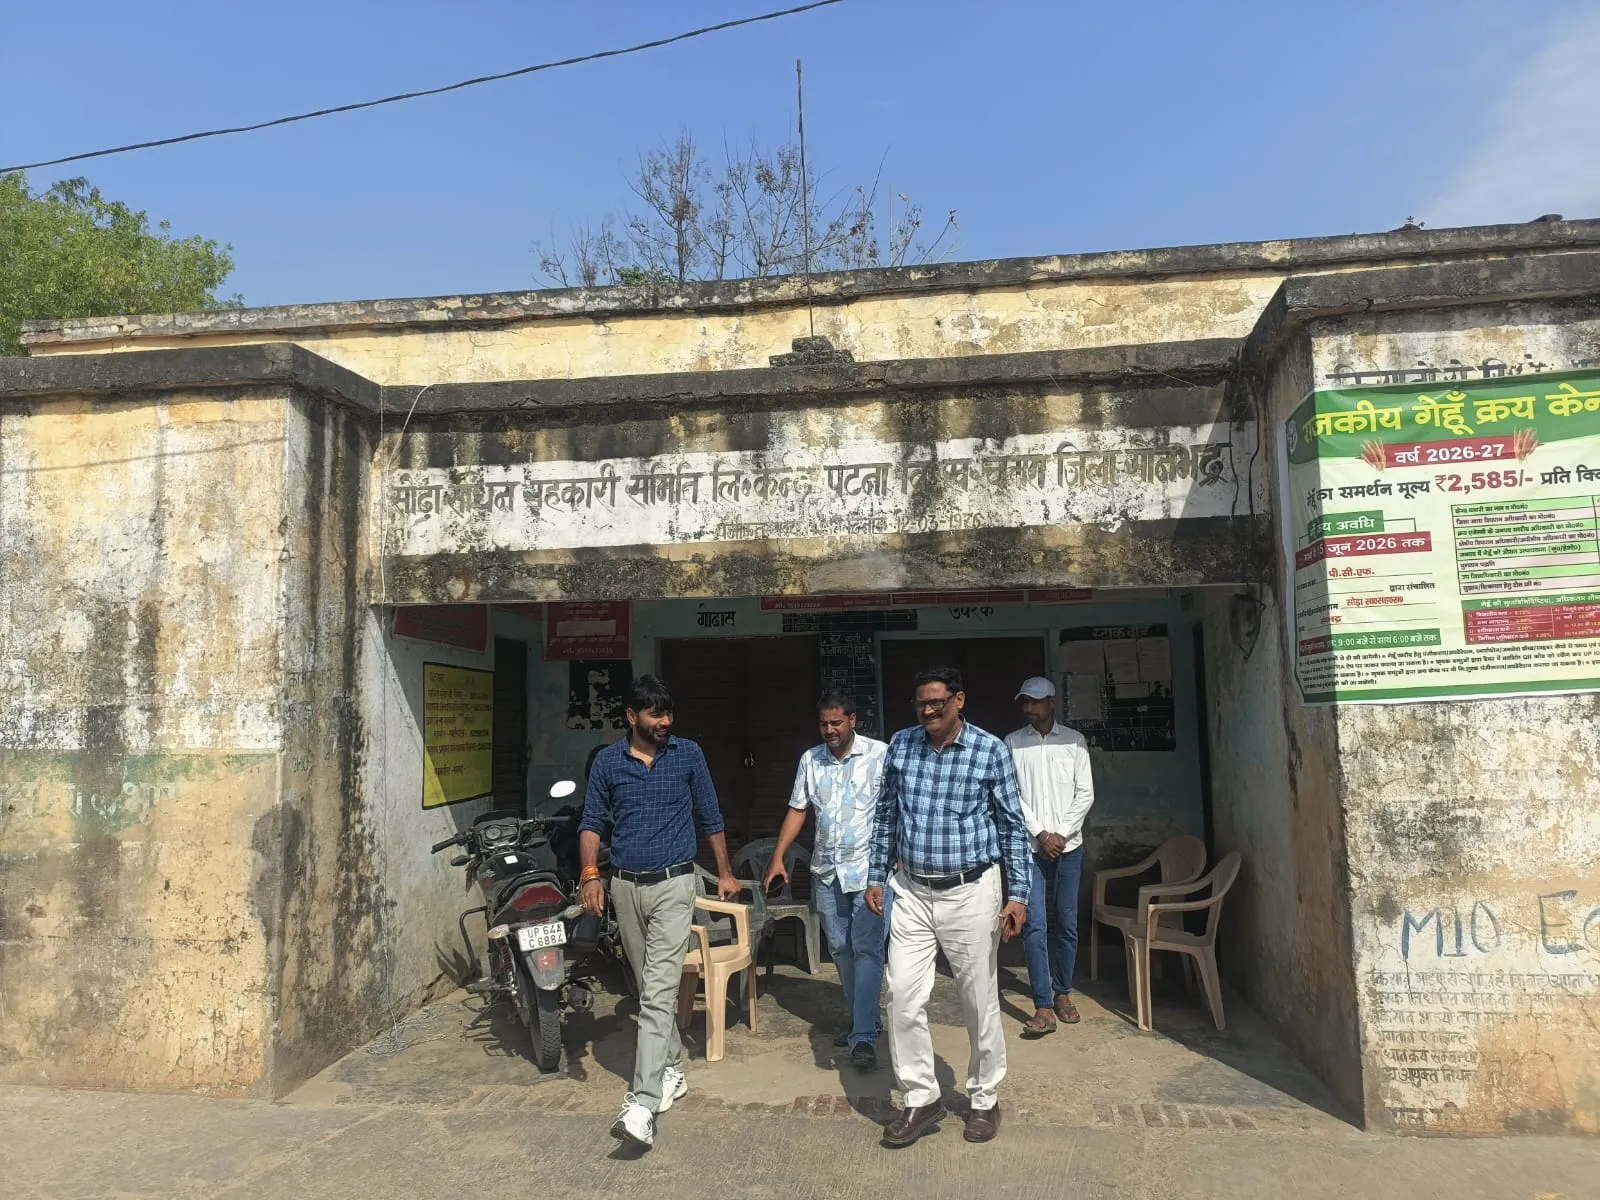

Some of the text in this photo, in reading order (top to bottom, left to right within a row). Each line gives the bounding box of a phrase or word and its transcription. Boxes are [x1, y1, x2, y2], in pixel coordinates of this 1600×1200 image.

[1414, 389, 1475, 435] गेहूँ
[1474, 394, 1535, 425] क्रय
[1394, 443, 1504, 464] वर्ष 2026-27
[523, 463, 621, 514] सहकारी
[626, 461, 708, 508] समिति
[823, 462, 893, 496] पटना
[1053, 441, 1117, 488] जिला
[1339, 482, 1392, 499] समर्थन
[1397, 481, 1430, 499] मूल्य
[1435, 468, 1533, 494] ₹2,585/-
[1540, 467, 1571, 485] प्रति
[1336, 516, 1375, 531] अवधि
[1328, 543, 1351, 557] जून
[1356, 538, 1396, 552] 2026
[1401, 537, 1425, 549] तक
[1328, 566, 1375, 578] पी.सी.एफ.
[1390, 582, 1435, 593] द्वारा संचालित
[1338, 638, 1355, 648] 9:00
[1356, 637, 1368, 647] बजे
[1369, 636, 1376, 646] से
[1393, 634, 1409, 644] 6:00
[1410, 634, 1422, 644] बजे
[1423, 632, 1437, 642] तक
[528, 928, 539, 938] UP
[528, 934, 563, 948] C 6884
